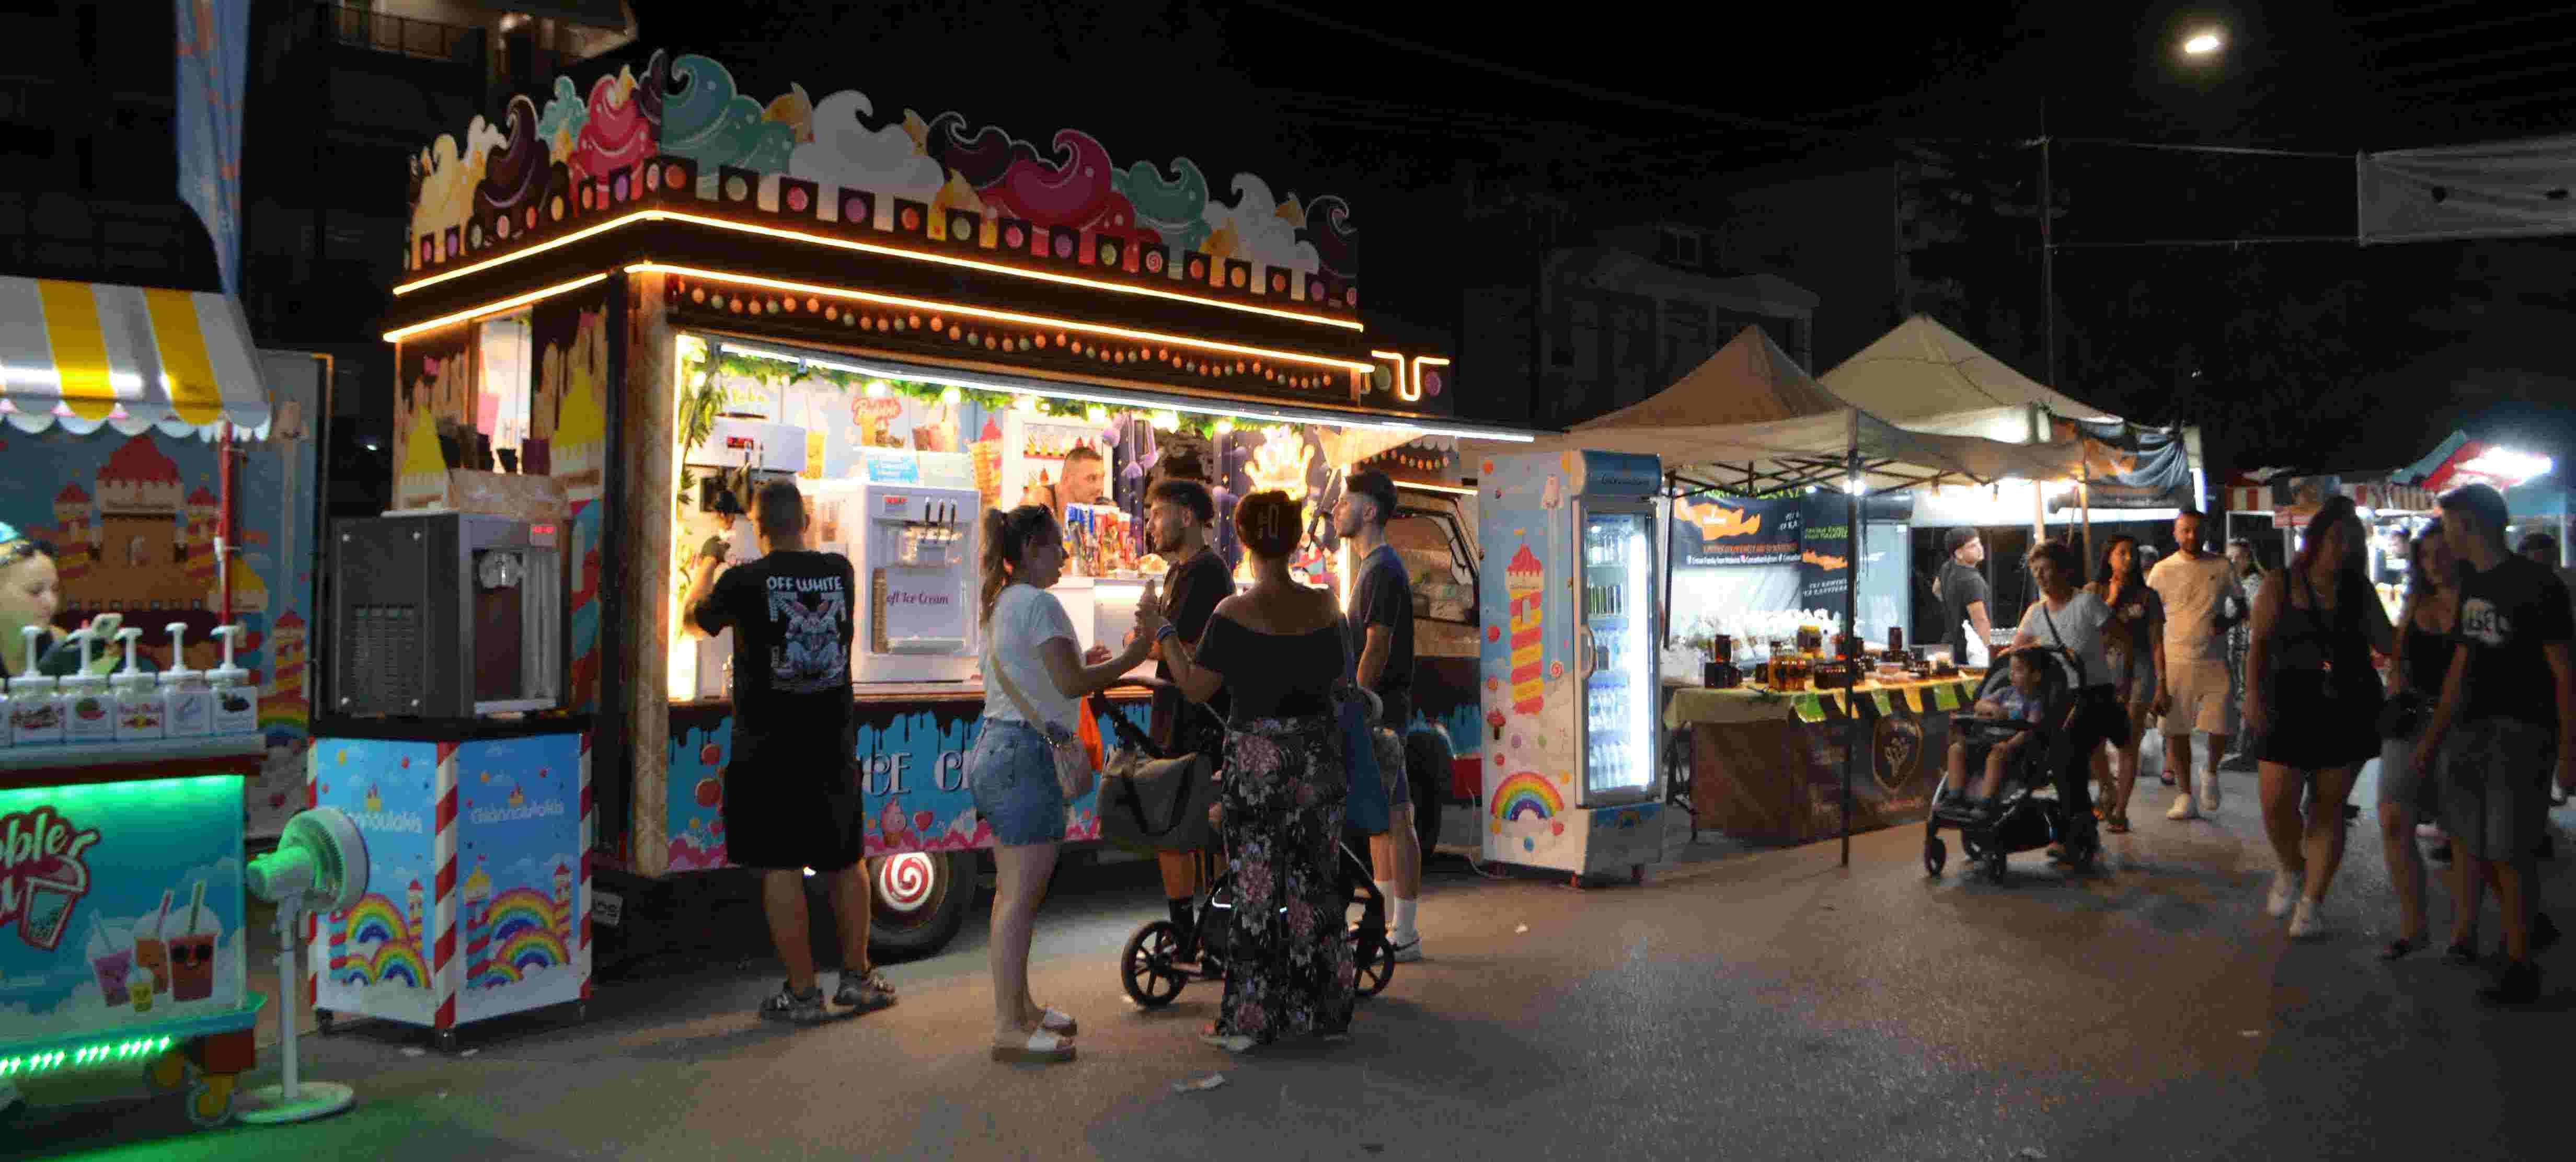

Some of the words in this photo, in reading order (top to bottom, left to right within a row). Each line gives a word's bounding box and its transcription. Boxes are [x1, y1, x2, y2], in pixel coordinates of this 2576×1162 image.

[766, 577, 794, 590] OFF
[795, 577, 845, 591] WHITE
[903, 591, 915, 604] Ice
[919, 589, 950, 605] Cream
